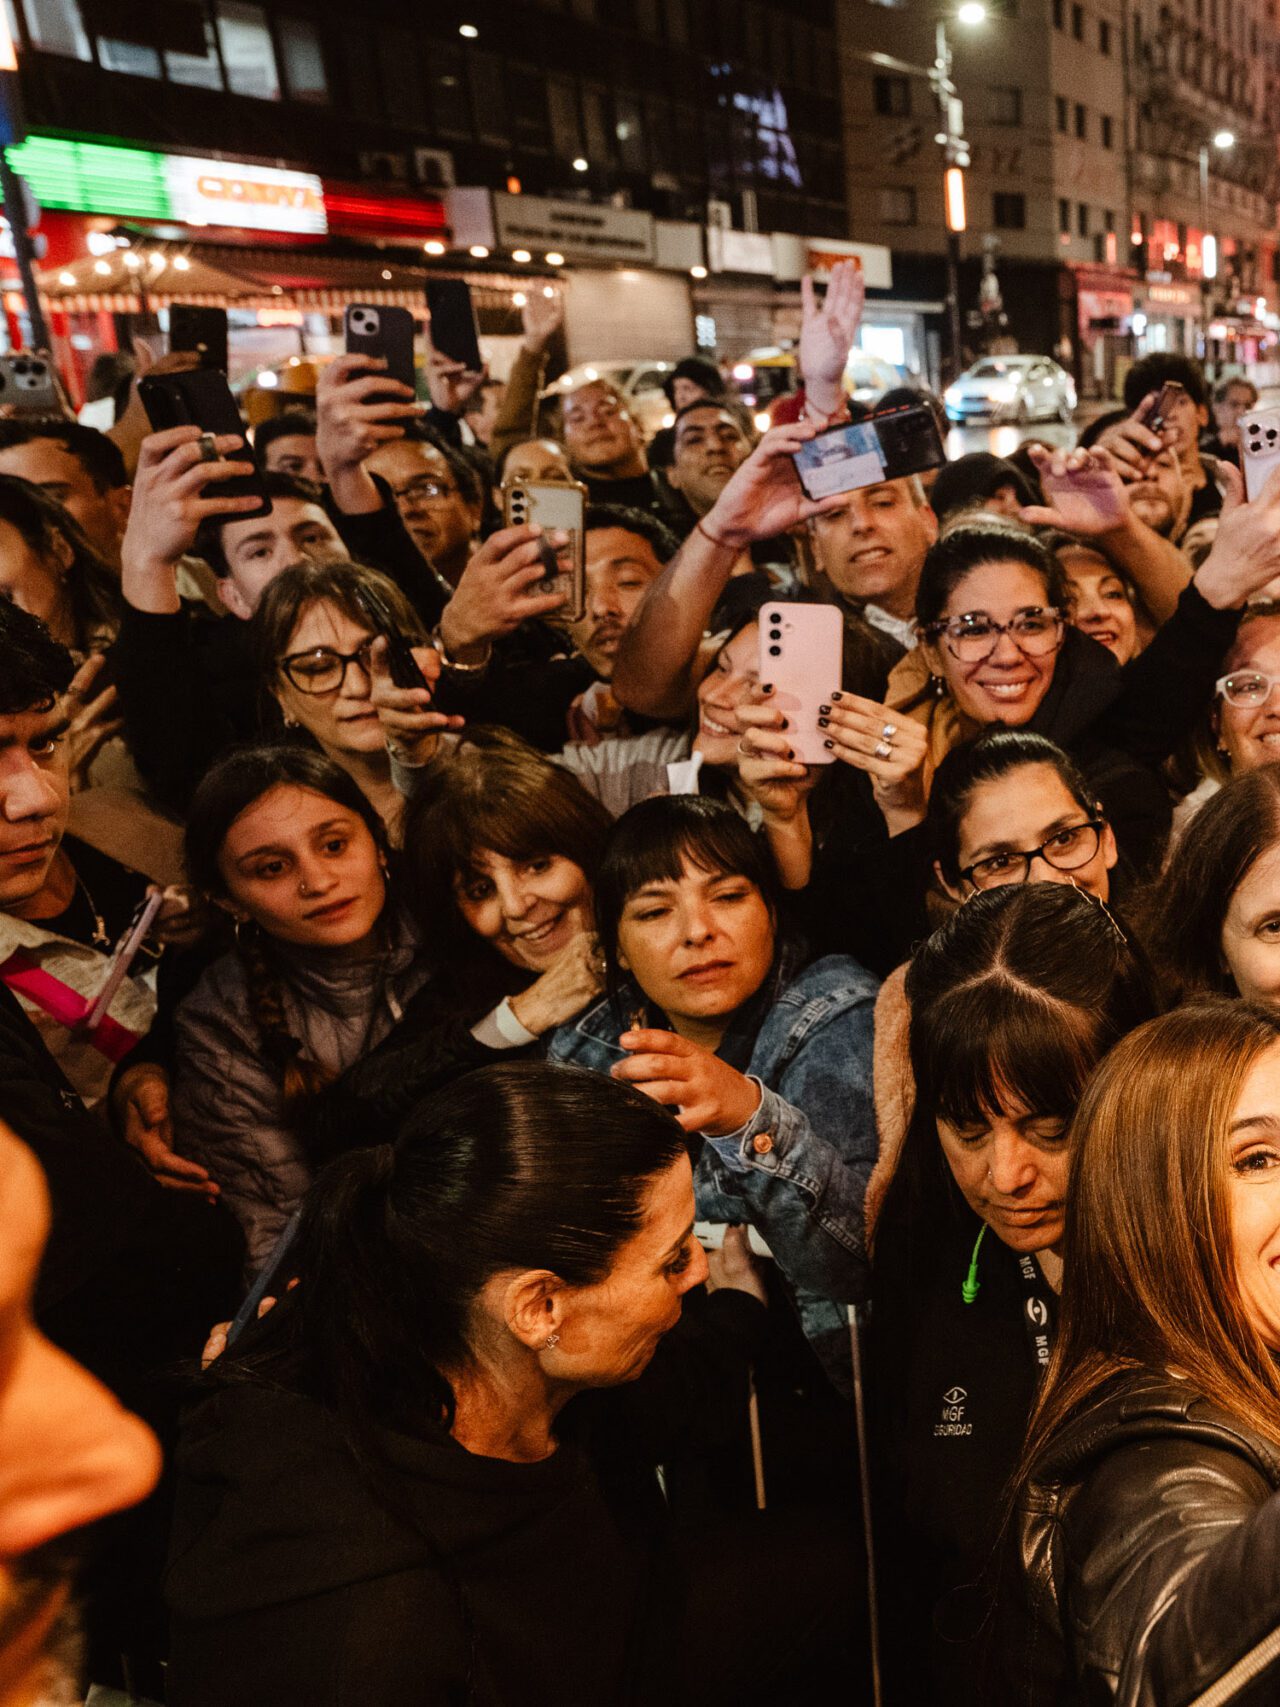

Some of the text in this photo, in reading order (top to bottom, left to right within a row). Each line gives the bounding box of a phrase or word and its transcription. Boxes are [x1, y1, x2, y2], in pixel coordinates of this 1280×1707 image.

[1019, 1256, 1036, 1279] MGF
[1035, 1335, 1050, 1365] MGF
[942, 1406, 965, 1421] MGF
